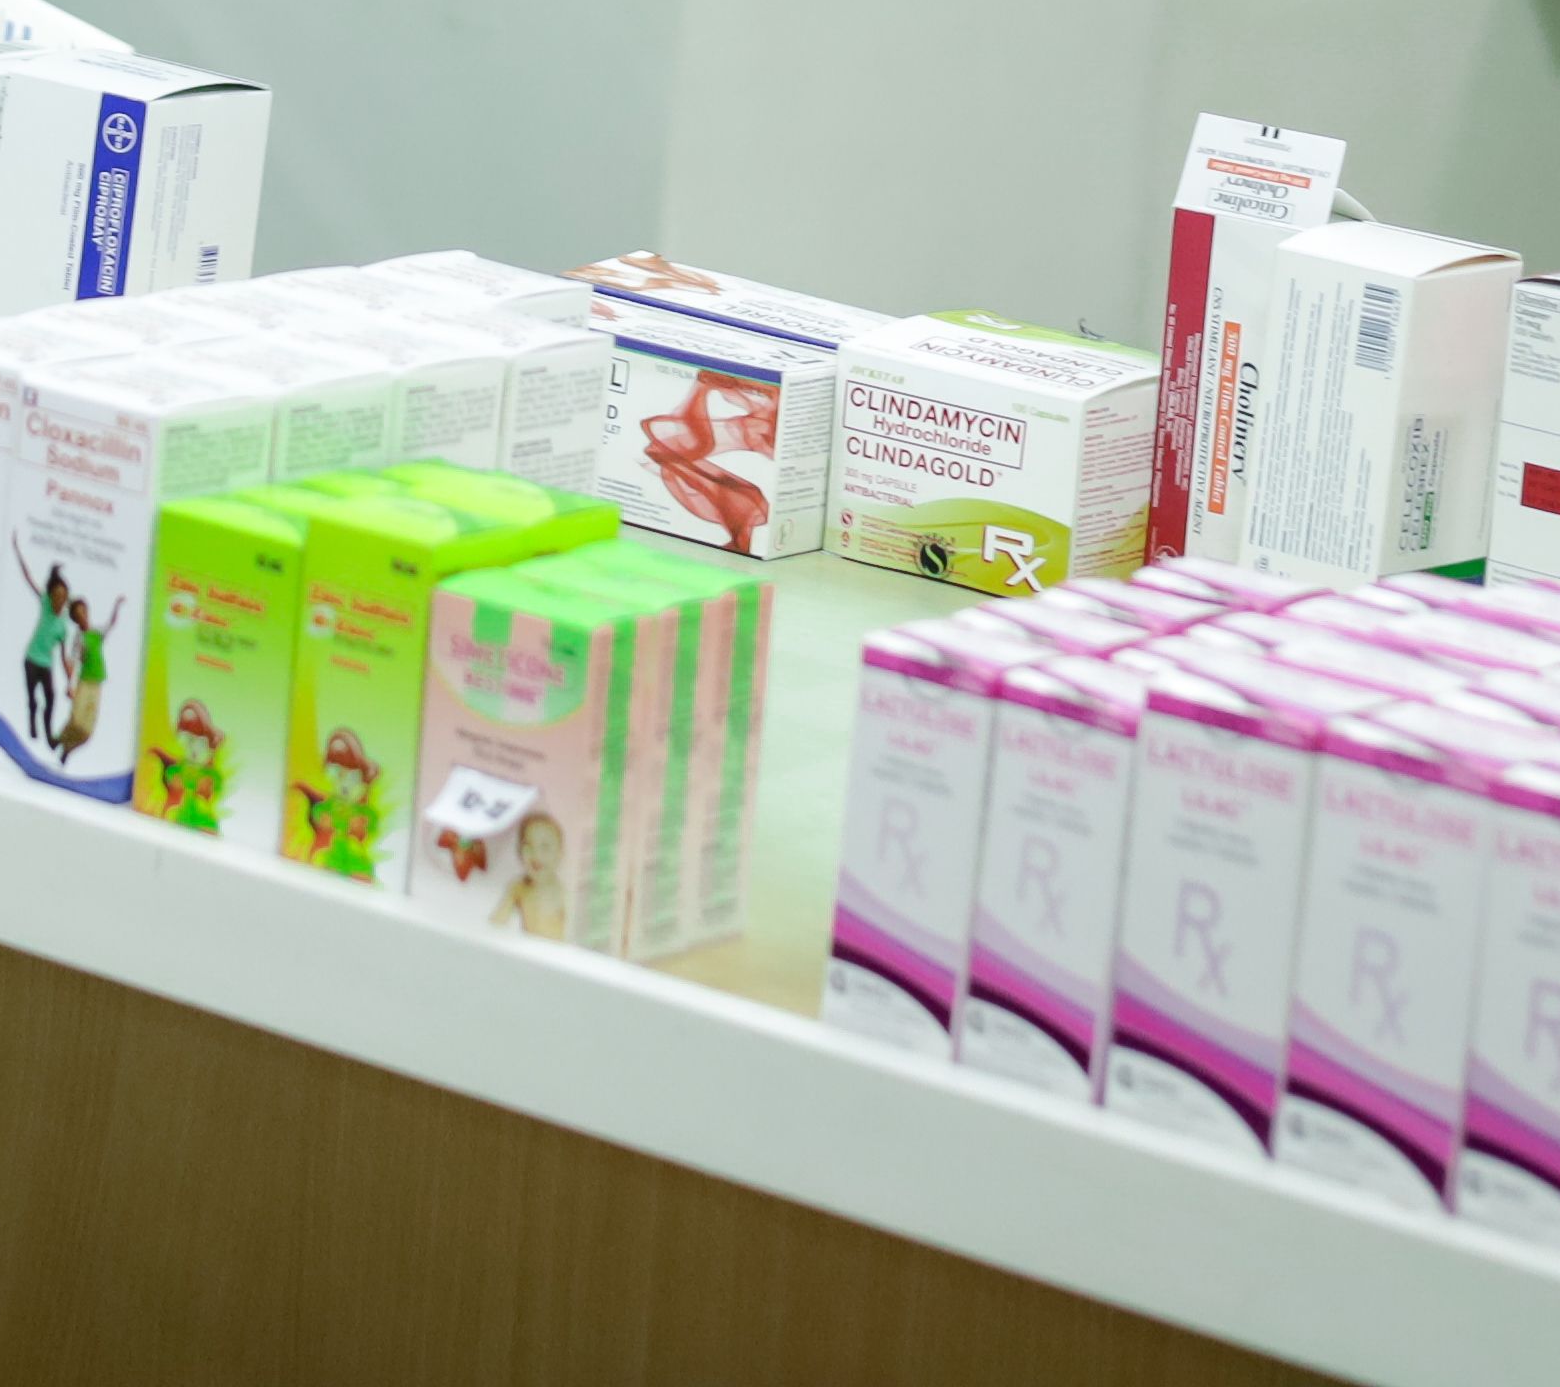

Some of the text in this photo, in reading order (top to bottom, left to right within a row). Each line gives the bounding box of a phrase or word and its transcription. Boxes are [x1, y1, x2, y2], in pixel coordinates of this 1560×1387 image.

[1214, 191, 1288, 219] Citicoline
[100, 172, 128, 294] CIPROFLOXACIN
[917, 342, 1095, 388] CLINDAMYCIN
[26, 411, 143, 463] Cloxacillin
[849, 388, 1022, 444] CLINDAMYCIN
[873, 414, 991, 455] Hydrochloride
[47, 444, 120, 482] Sodium
[846, 437, 995, 487] CLINDAGOLD
[875, 474, 917, 493] CAPSULE
[46, 478, 113, 515] Pannox
[843, 483, 914, 508] ANTIBACTERIAL
[1193, 497, 1205, 535] AGENT
[983, 524, 1047, 592] Rx
[861, 689, 979, 741] LACTULOSE
[1001, 727, 1117, 778] LACTULOSE
[1148, 737, 1293, 801] LACTULOSE
[1326, 784, 1474, 843] LACTULOSE
[875, 796, 927, 901] Rx
[1015, 834, 1065, 938] Rx
[1176, 878, 1232, 998] Rx
[1351, 927, 1405, 1042] Rx
